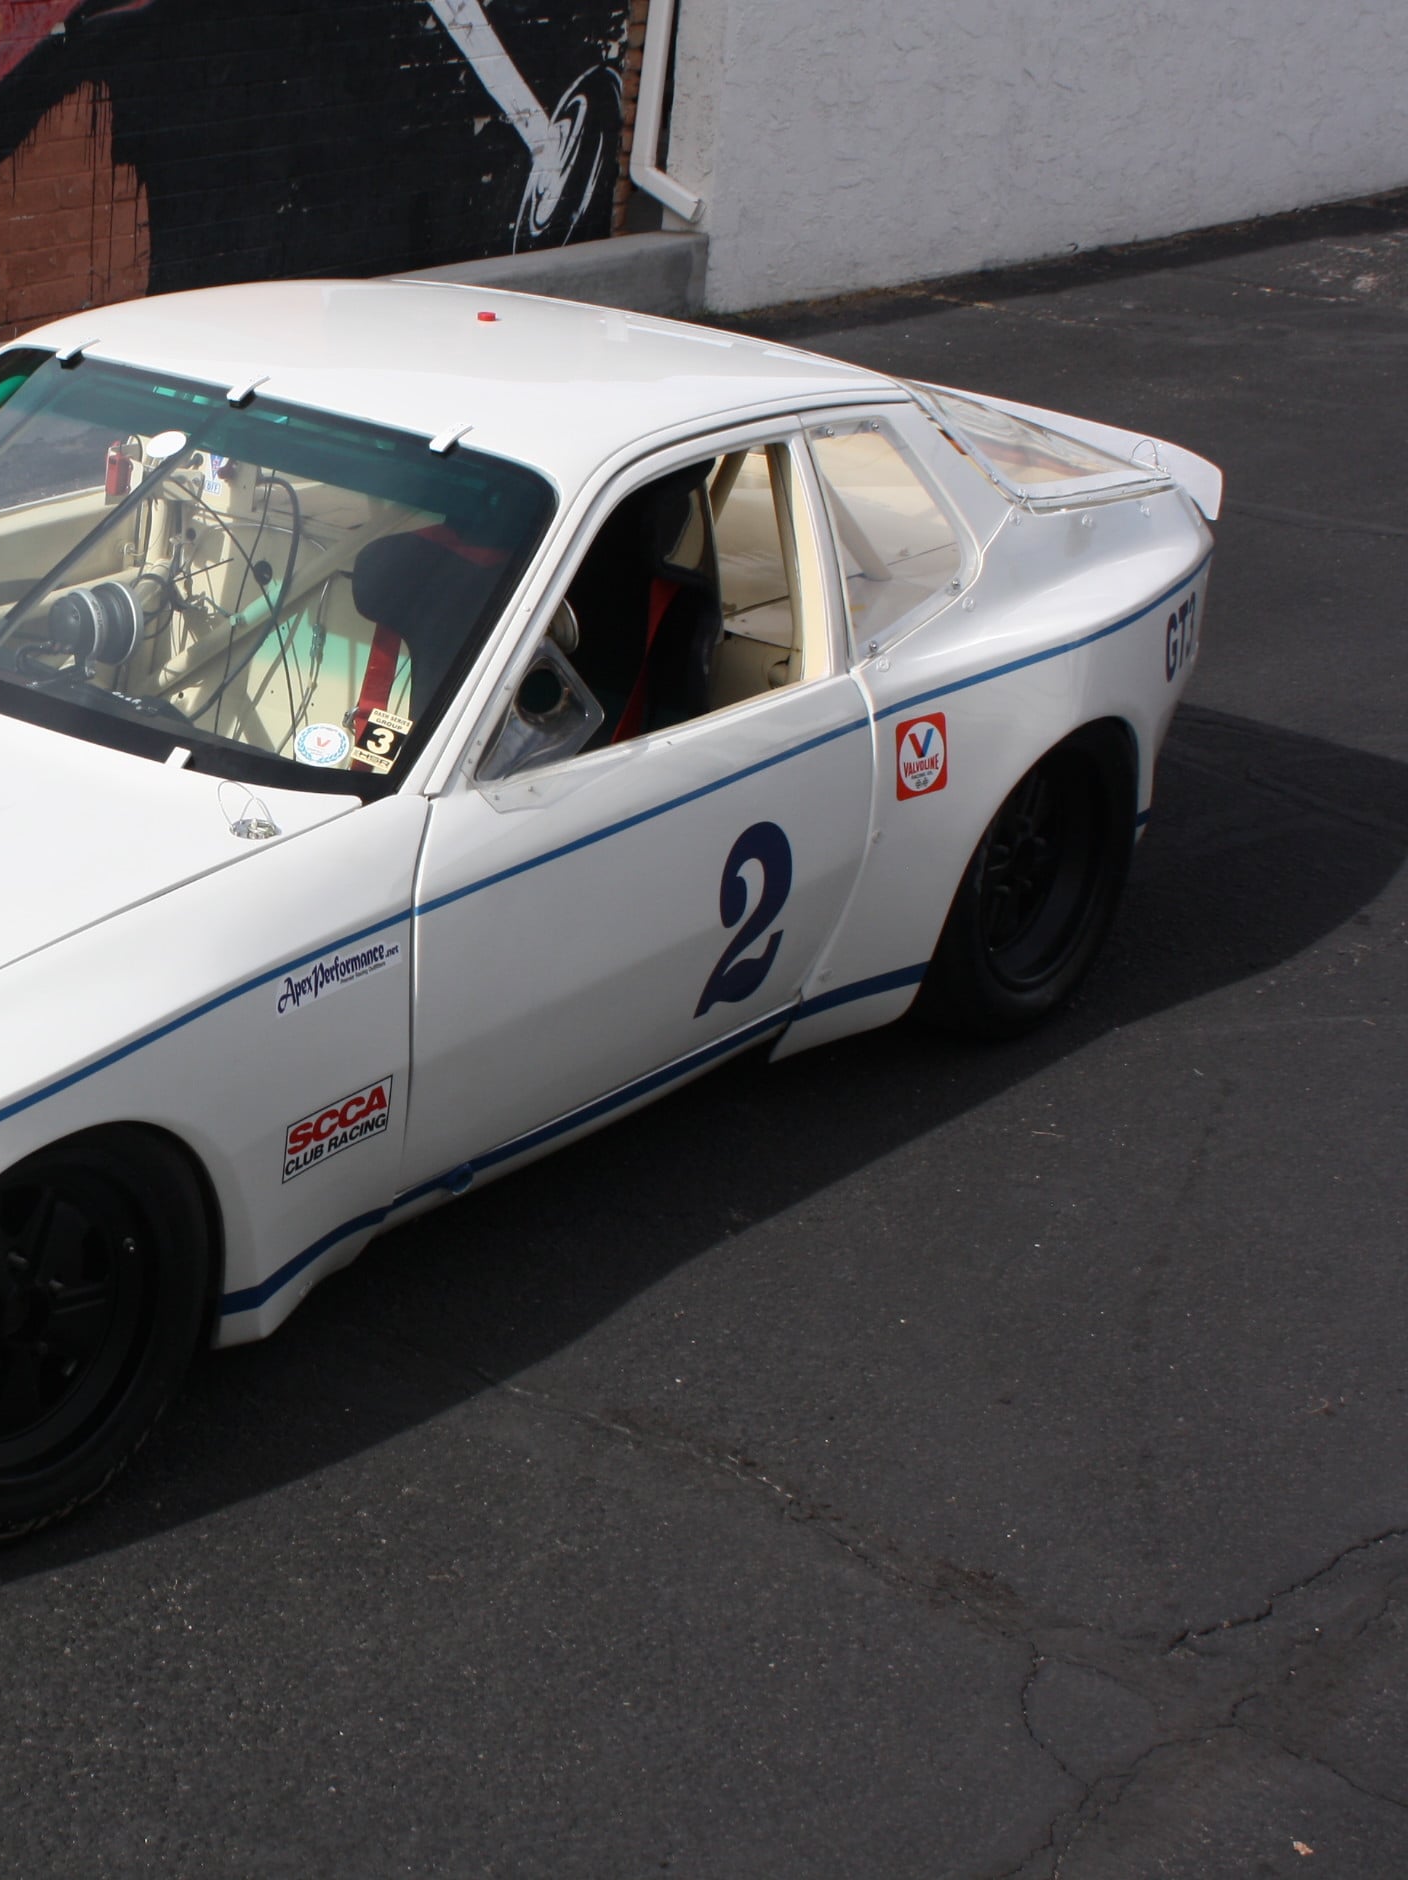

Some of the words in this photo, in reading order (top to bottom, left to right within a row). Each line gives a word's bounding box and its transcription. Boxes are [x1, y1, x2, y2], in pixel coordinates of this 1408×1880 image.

[376, 717, 403, 730] GROUP
[390, 715, 411, 727] SERIES
[367, 727, 394, 755] 3
[903, 753, 939, 778] VALVOLINE
[693, 820, 793, 1019] 2
[277, 976, 313, 1014] Apex
[287, 1085, 388, 1156] SCCA
[285, 1143, 325, 1176] CLUB
[327, 1113, 387, 1153] RACING
